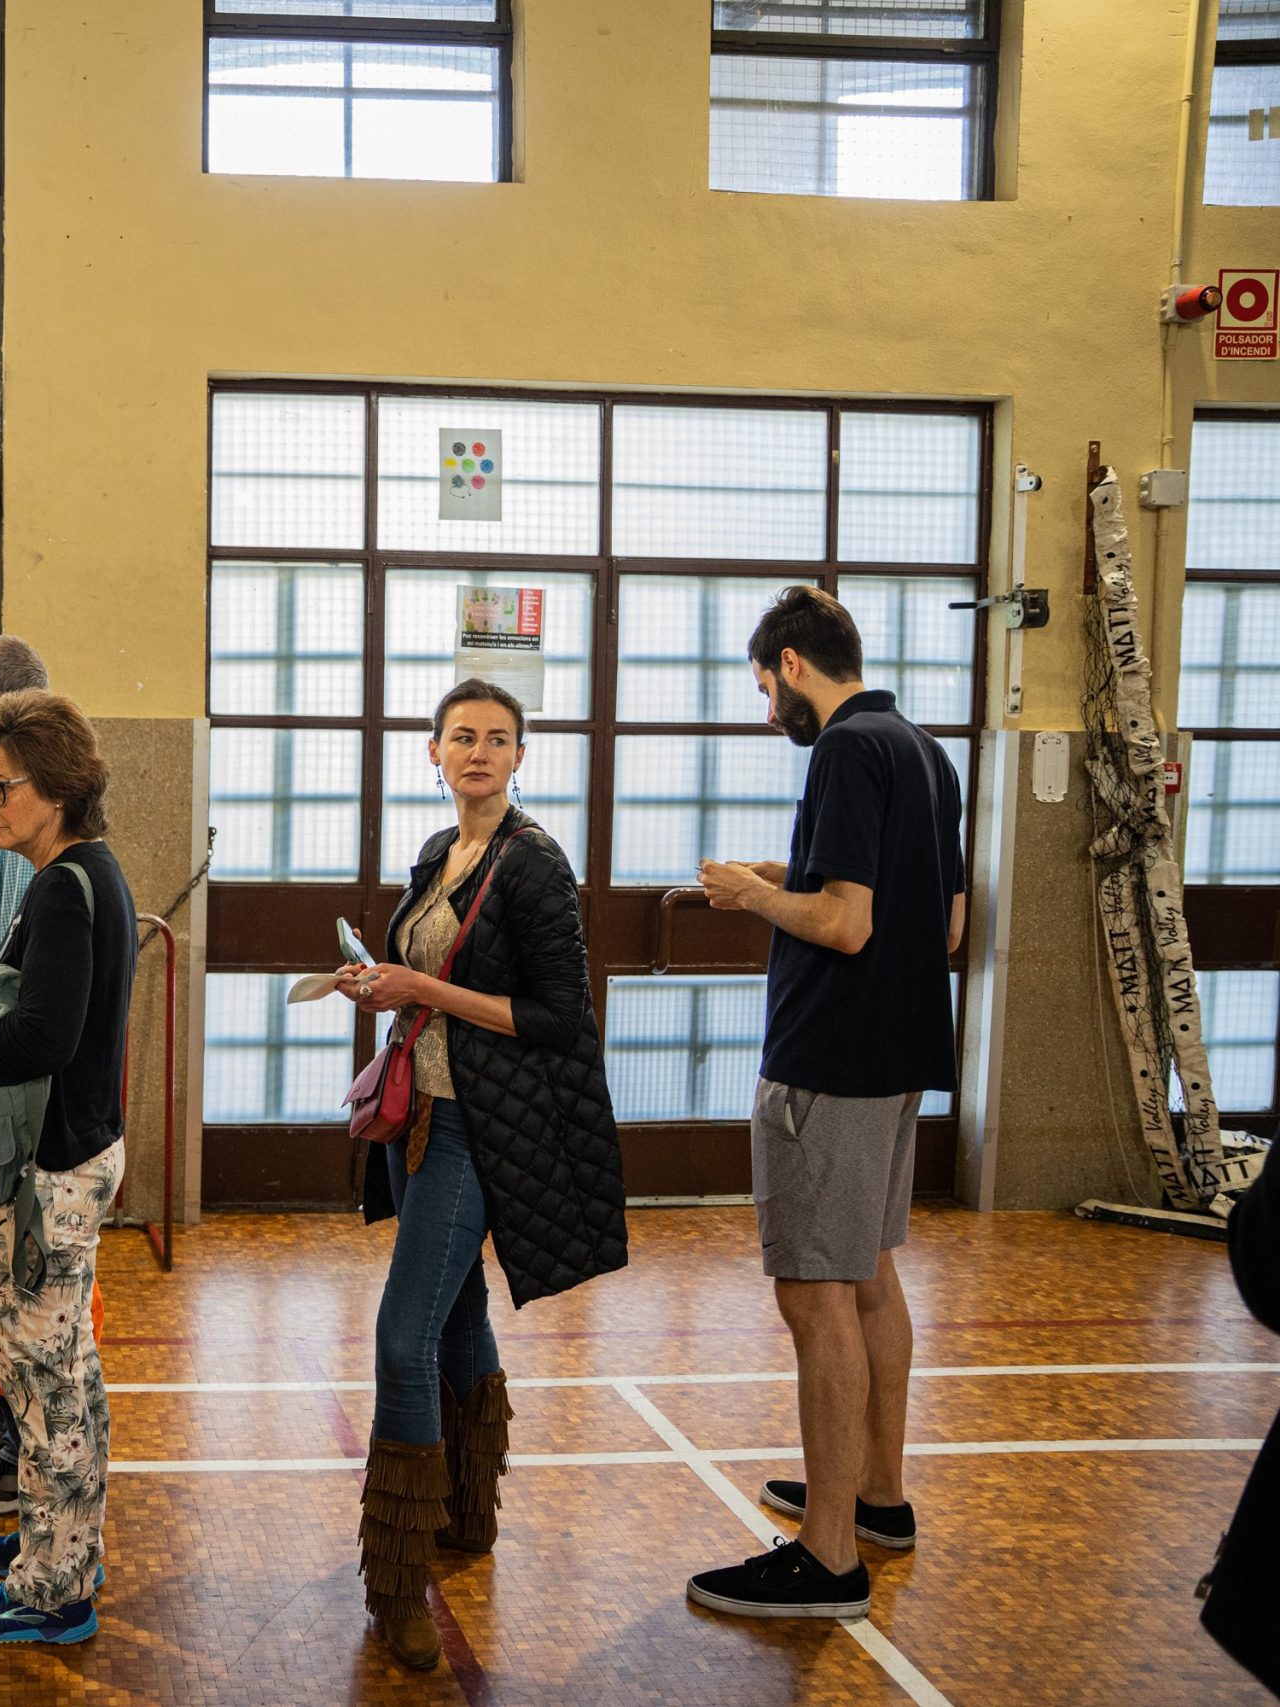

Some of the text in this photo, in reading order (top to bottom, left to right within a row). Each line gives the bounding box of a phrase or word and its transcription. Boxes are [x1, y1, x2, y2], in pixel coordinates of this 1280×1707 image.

[1219, 335, 1274, 344] POLSADOR
[1221, 347, 1271, 356] D'INCENDI
[1157, 906, 1182, 948] Volley
[1142, 1088, 1165, 1132] Volley
